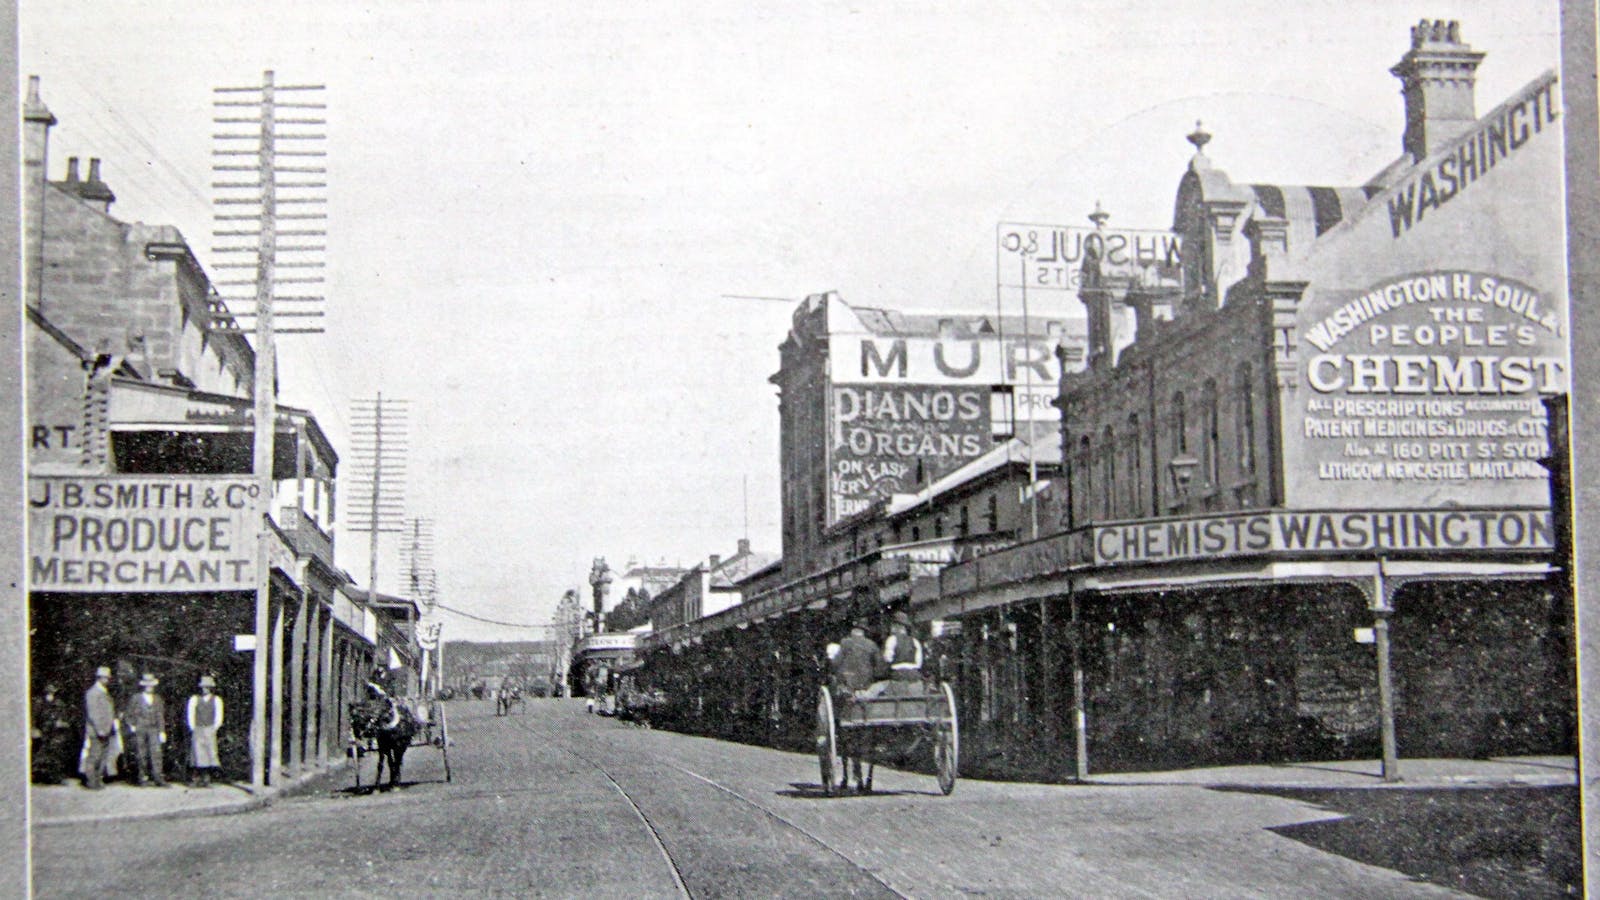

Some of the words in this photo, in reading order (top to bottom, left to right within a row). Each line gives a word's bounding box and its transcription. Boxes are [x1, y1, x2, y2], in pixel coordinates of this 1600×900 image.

[1305, 275, 1448, 352] WASHINGTON
[1429, 307, 1485, 322] THE
[1370, 325, 1537, 346] PEOPLE'S
[1307, 355, 1565, 394] CHEMIST
[1333, 398, 1465, 416] PRESCRIPTIONS
[1304, 417, 1361, 437] PATENT
[1363, 418, 1450, 437] MEDICINES
[1455, 418, 1508, 437] DRUGS
[850, 428, 981, 456] ORGANS
[1393, 443, 1420, 458] 160
[1429, 443, 1470, 458] PITT
[838, 460, 863, 474] ON
[1386, 462, 1467, 479] NEWCASTLE
[832, 471, 870, 495] VERY
[866, 461, 909, 482] EASY
[203, 487, 219, 508] &
[53, 514, 232, 551] PRODUCE
[1098, 516, 1272, 560] CHEMISTS
